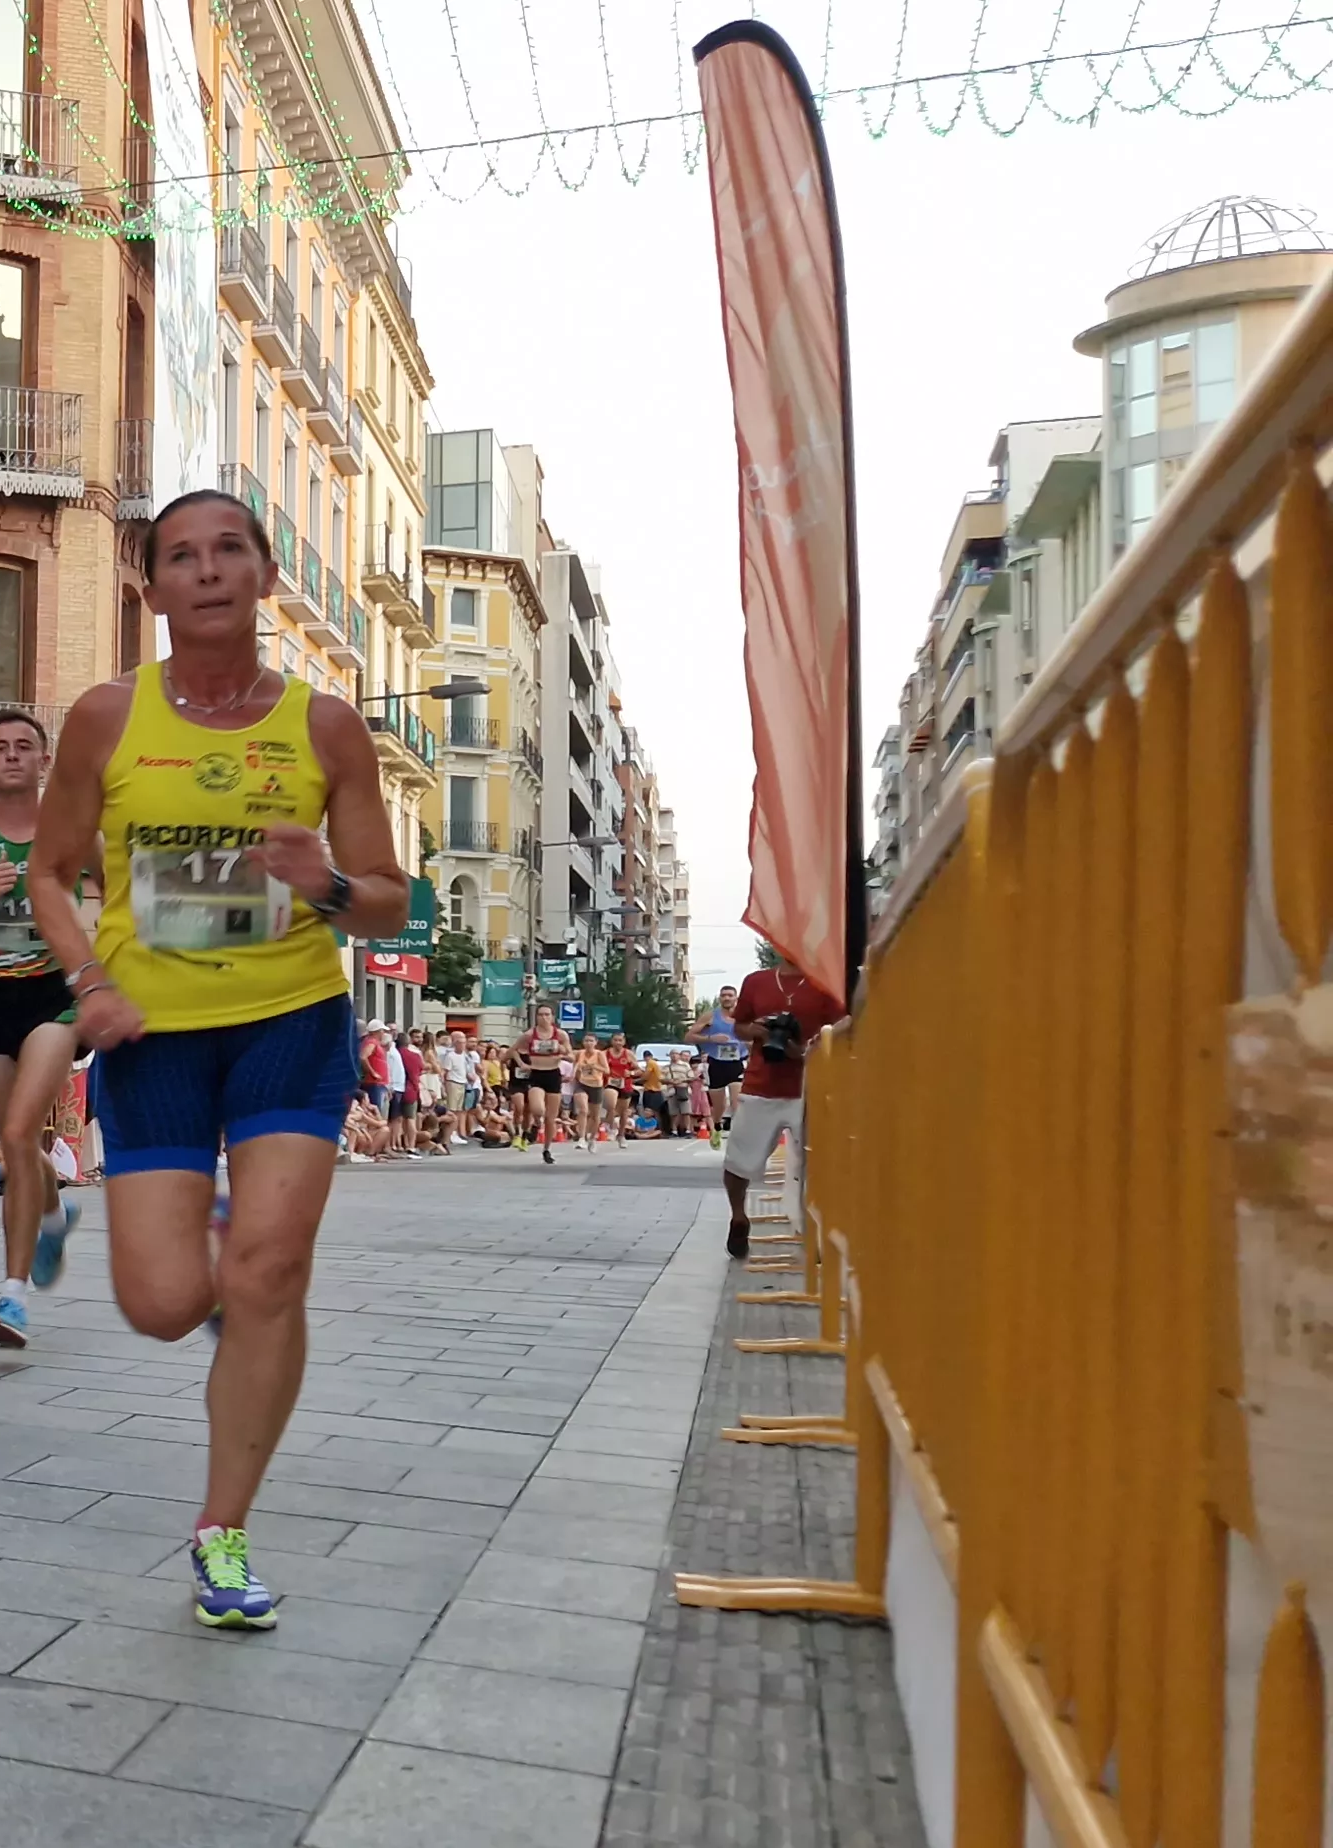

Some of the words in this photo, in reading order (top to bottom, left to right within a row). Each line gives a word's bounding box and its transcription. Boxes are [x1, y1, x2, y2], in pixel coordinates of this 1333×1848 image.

[181, 849, 243, 883] 17
[4, 898, 33, 917] 11
[406, 919, 428, 930] nzo
